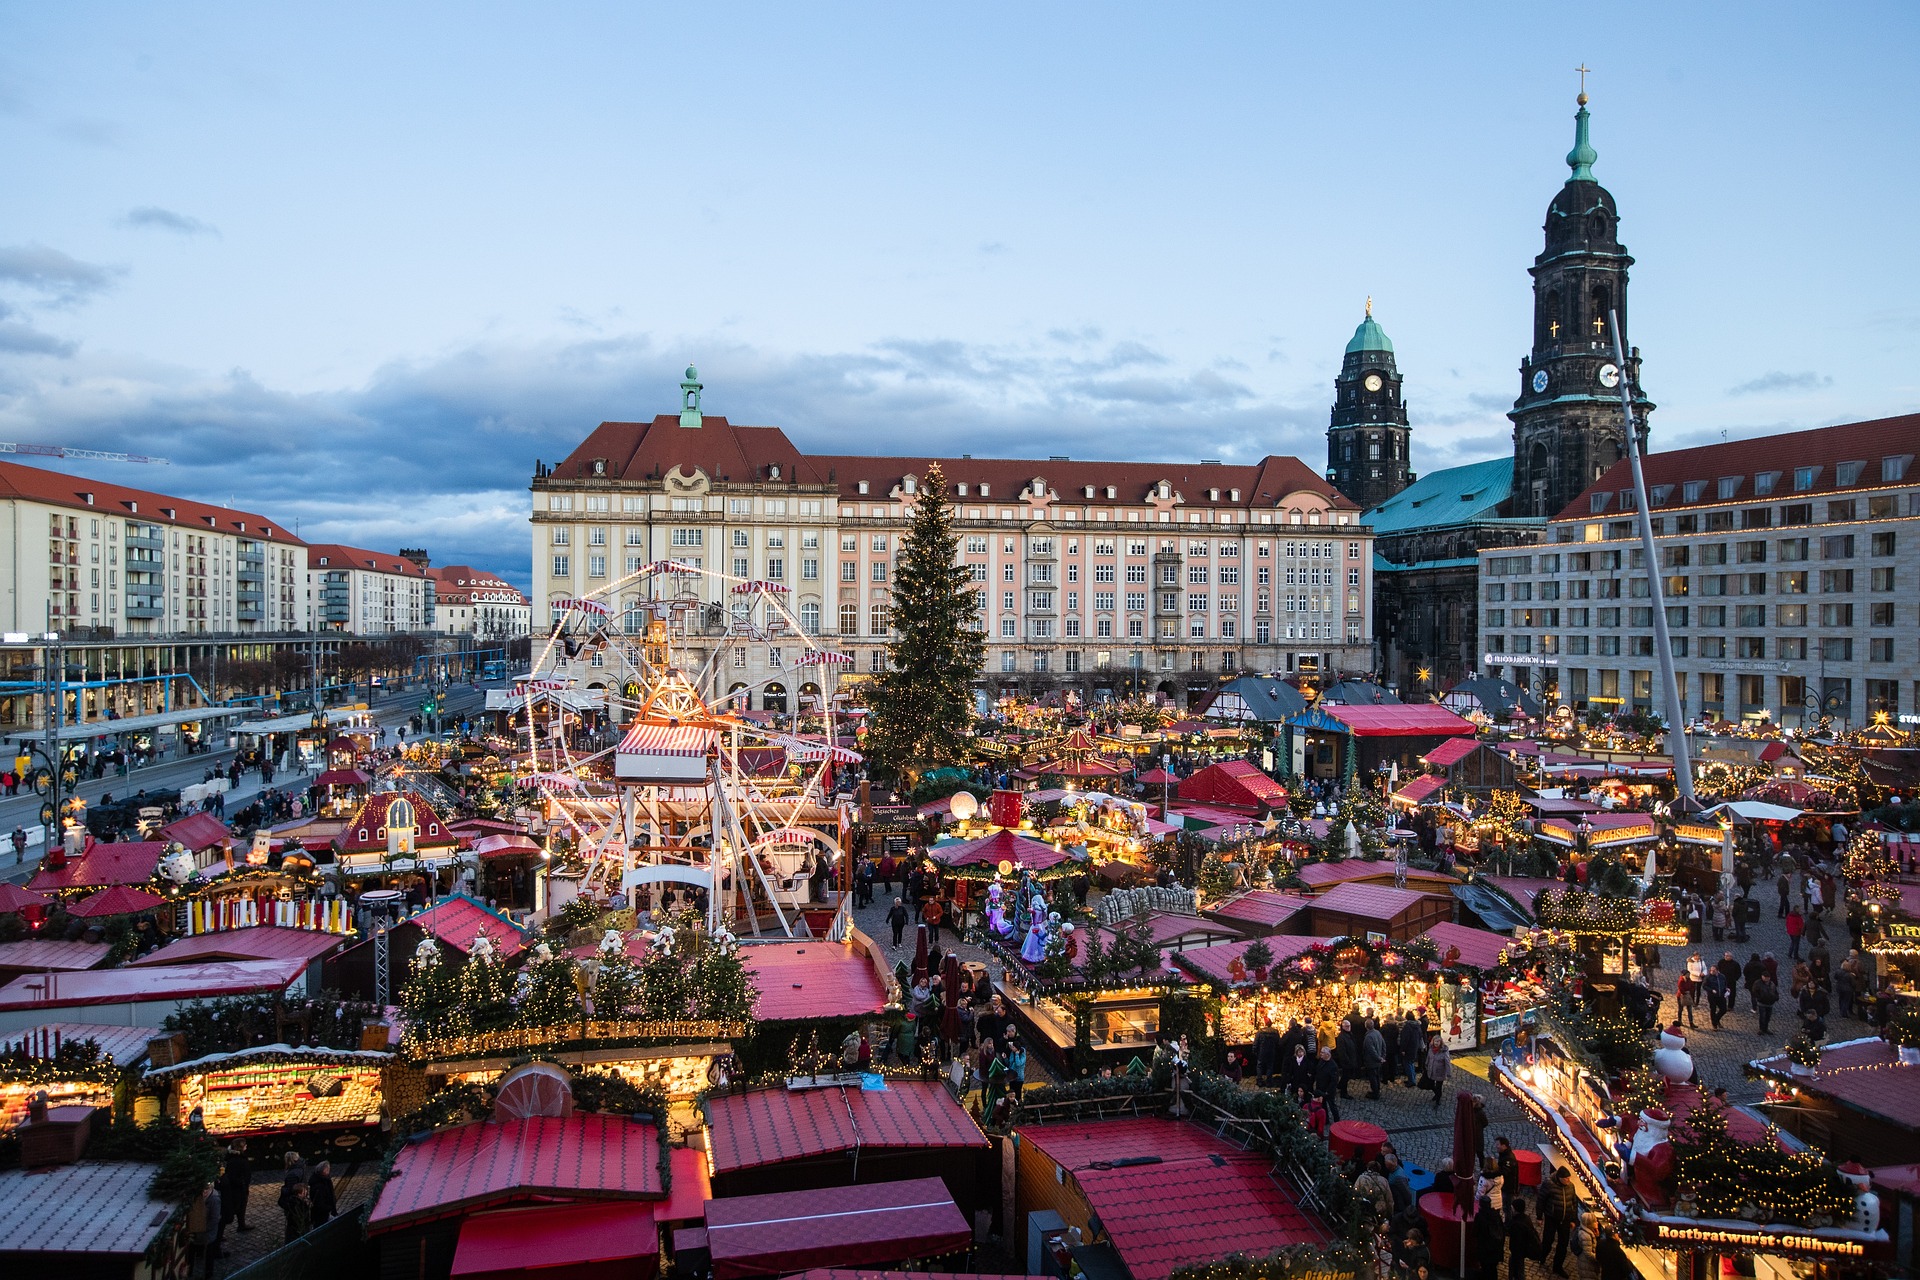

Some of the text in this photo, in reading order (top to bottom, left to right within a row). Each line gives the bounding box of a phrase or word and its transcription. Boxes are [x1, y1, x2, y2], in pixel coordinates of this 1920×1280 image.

[428, 862, 434, 871] D
[1658, 1225, 1864, 1256] Rostbratwurst Glühwein
